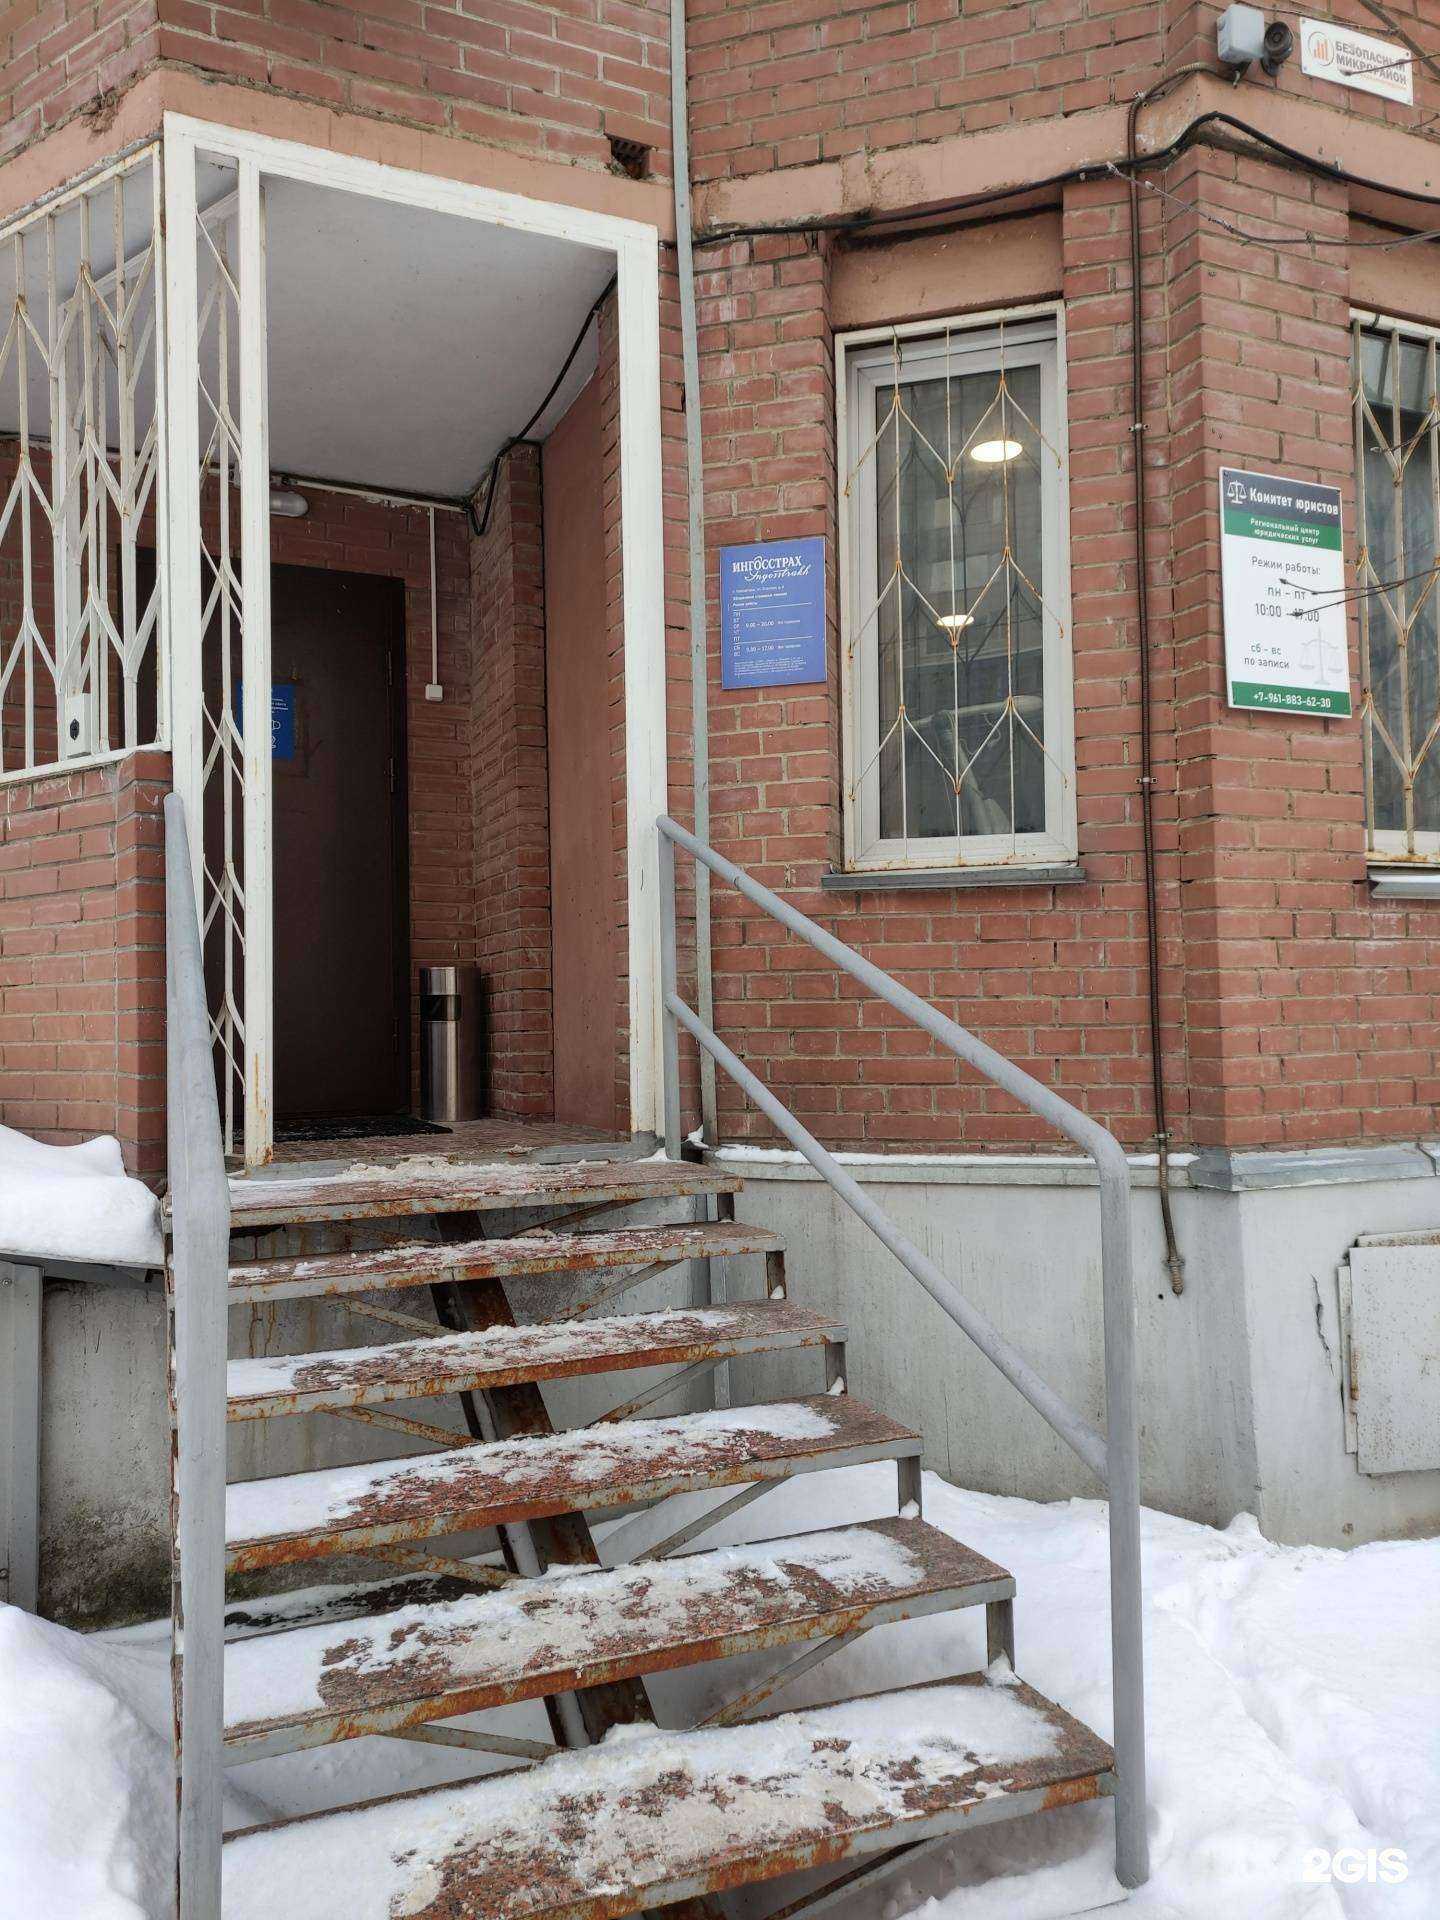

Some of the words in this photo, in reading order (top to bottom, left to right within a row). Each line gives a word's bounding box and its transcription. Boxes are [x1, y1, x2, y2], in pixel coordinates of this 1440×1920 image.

[1249, 487, 1293, 508] Комитет
[1295, 498, 1339, 516] юристов
[1250, 517, 1299, 533] Региональный
[1300, 527, 1320, 536] центр
[1254, 528, 1300, 541] юридических
[1301, 536, 1318, 545] услуг
[732, 555, 802, 573] ИНГОССТРАХ
[1251, 555, 1283, 570] Режим
[1285, 562, 1321, 577] работы:
[744, 564, 812, 584] Ingosstrakh
[1294, 590, 1306, 600] пт
[1251, 643, 1261, 653] сб
[1244, 656, 1255, 666] по
[1258, 659, 1290, 669] записи
[1253, 691, 1331, 708] +7-961-883-62-30
